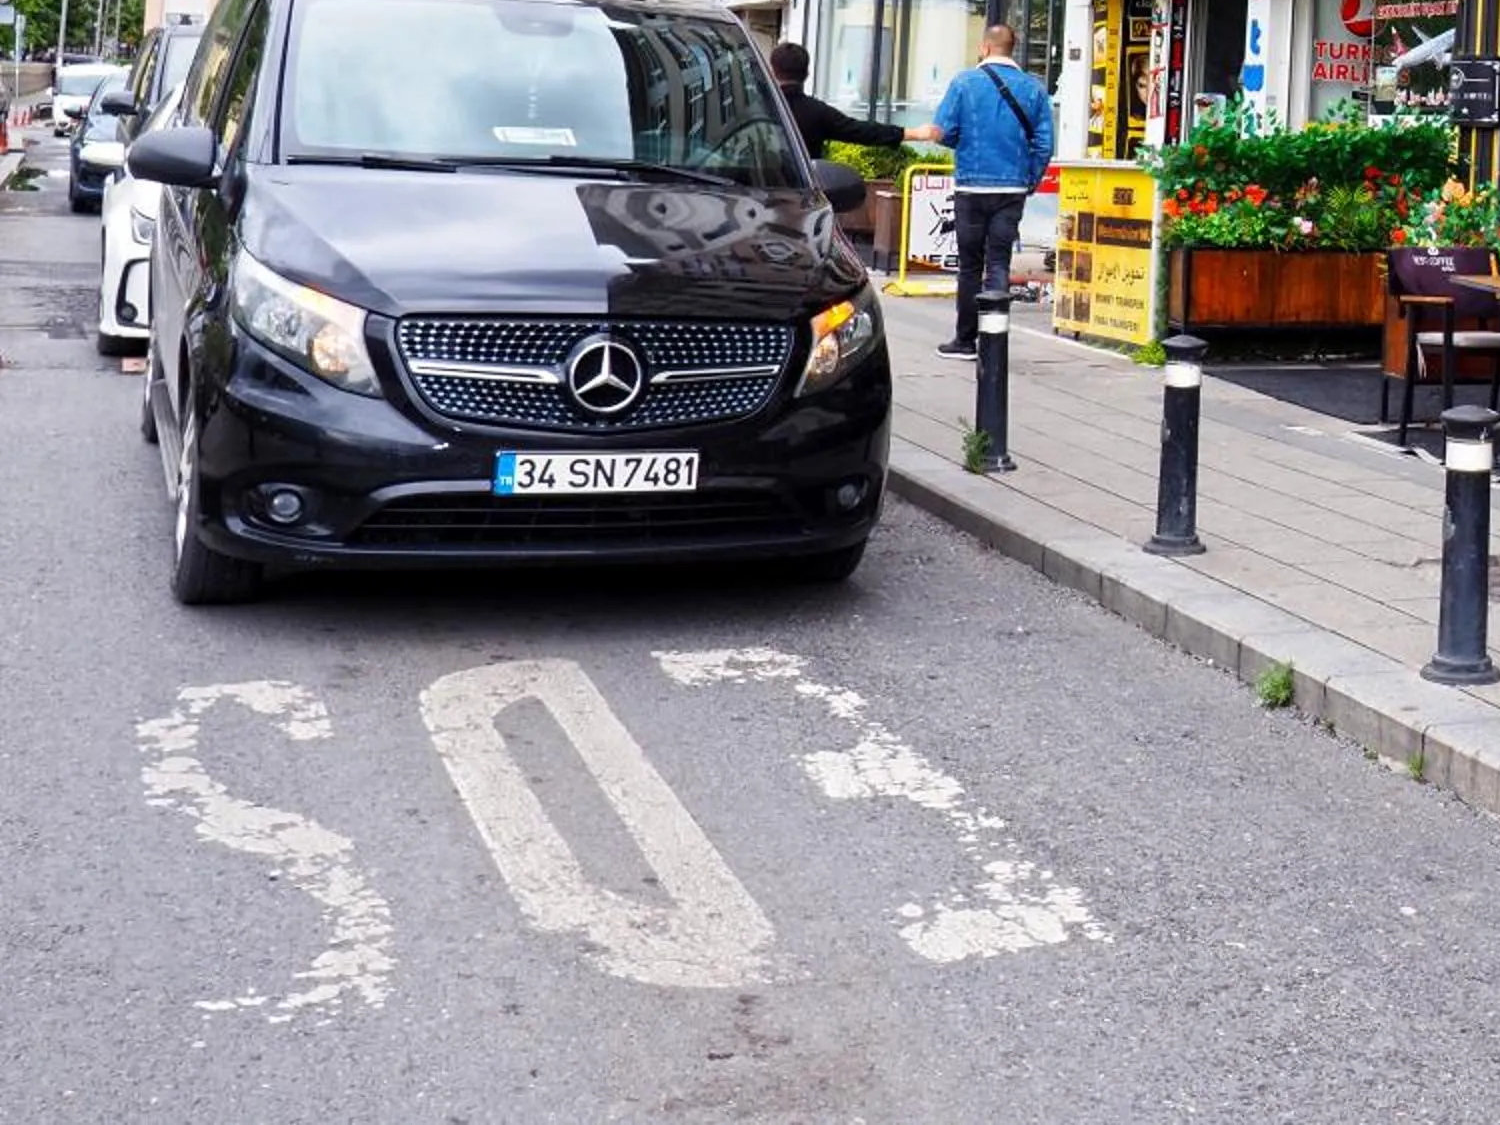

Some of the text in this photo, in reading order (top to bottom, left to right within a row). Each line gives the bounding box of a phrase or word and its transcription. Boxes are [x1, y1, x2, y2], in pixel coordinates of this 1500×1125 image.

[517, 456, 695, 489] 34 SN 7481
